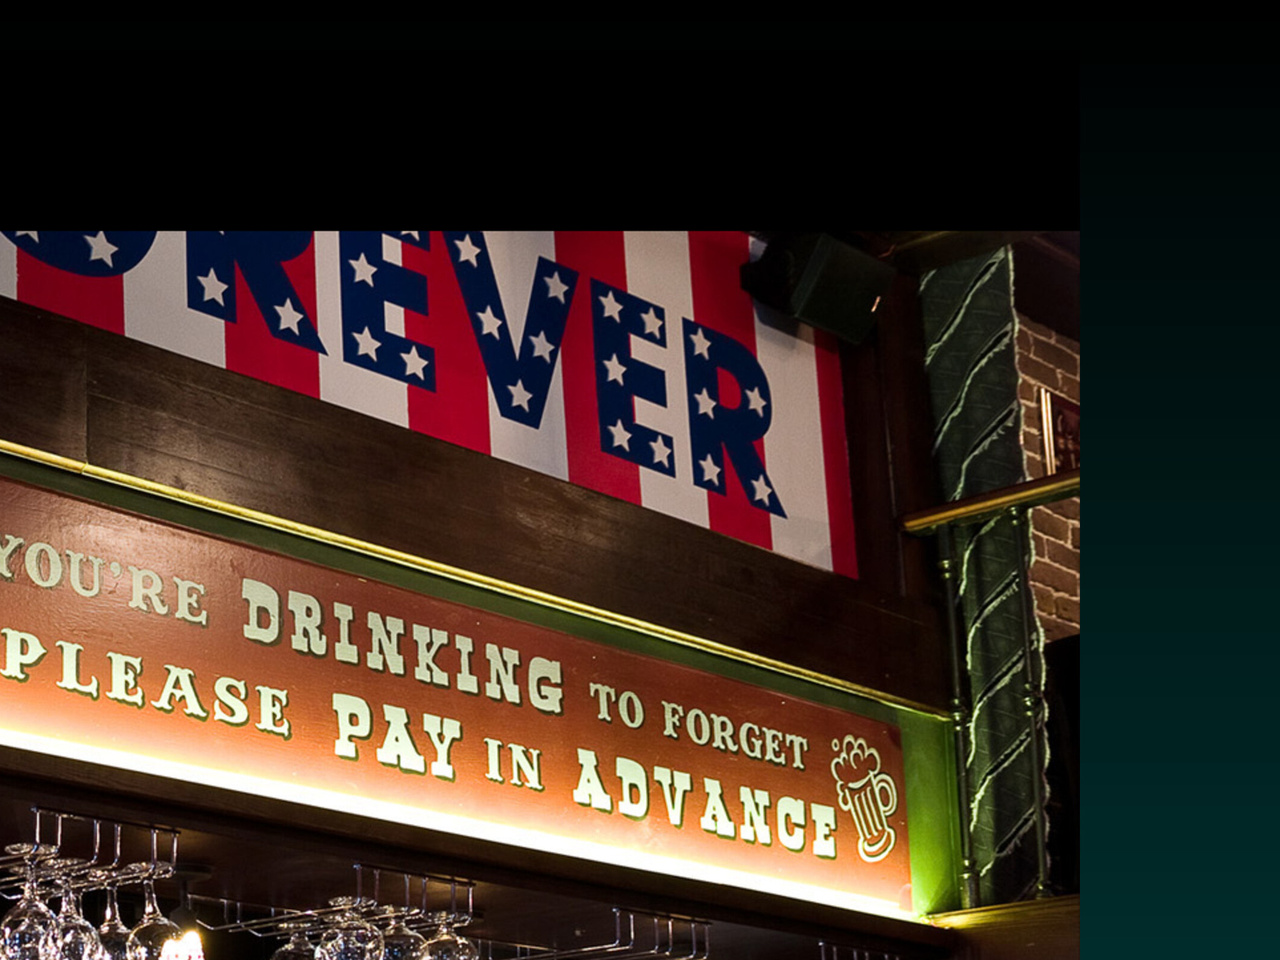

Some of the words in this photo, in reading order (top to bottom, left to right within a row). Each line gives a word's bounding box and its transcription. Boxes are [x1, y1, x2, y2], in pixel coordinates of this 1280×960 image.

[0, 628, 292, 740] PLEASE
[332, 693, 462, 779] PAY
[483, 738, 545, 791] IN
[572, 748, 838, 859] ADVANCE
[241, 577, 564, 714] DRINKING
[589, 682, 645, 728] TO
[661, 701, 809, 769] FORGET
